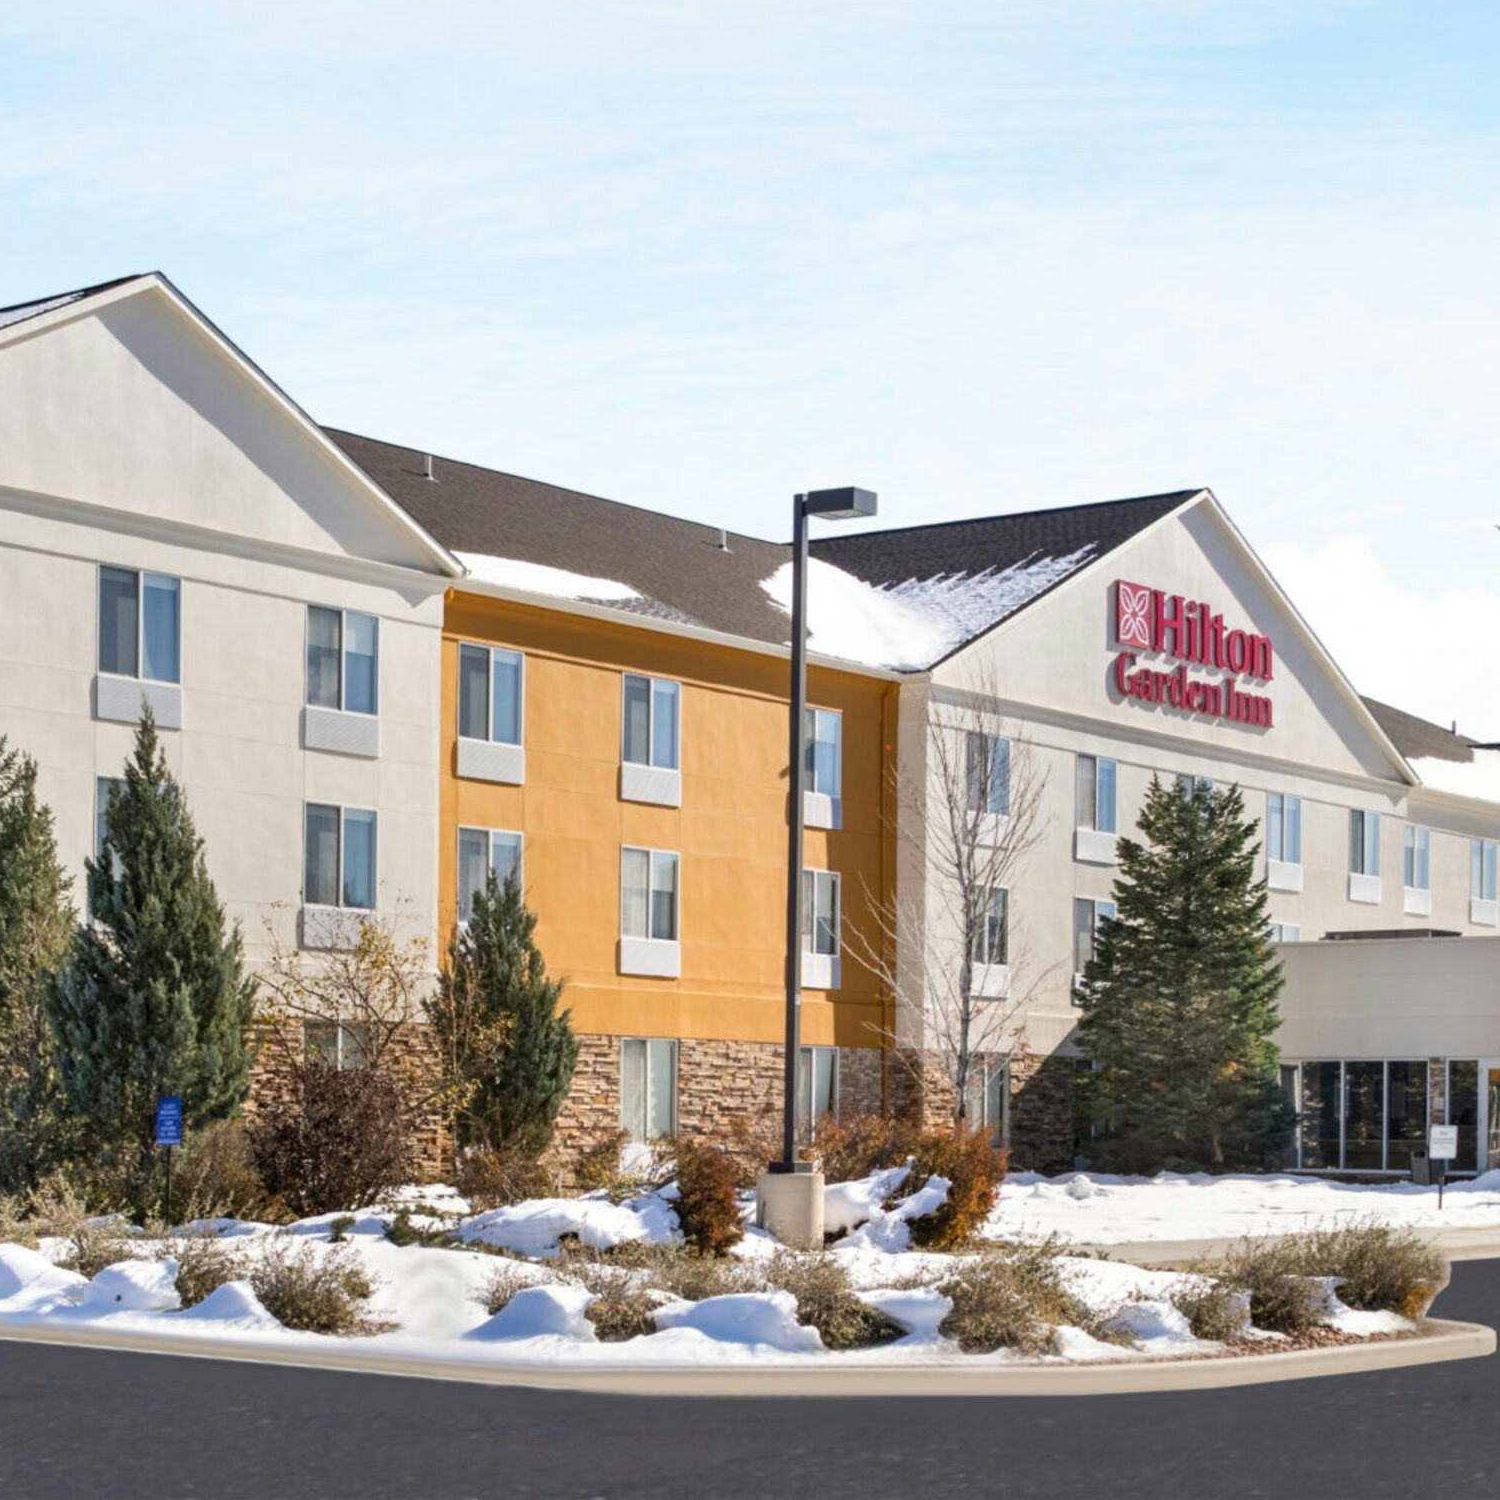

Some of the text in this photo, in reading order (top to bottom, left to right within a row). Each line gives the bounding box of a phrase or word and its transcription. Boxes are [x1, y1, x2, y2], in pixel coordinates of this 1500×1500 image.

[1153, 589, 1273, 681] Hilton
[1116, 651, 1274, 728] Garden Inn
